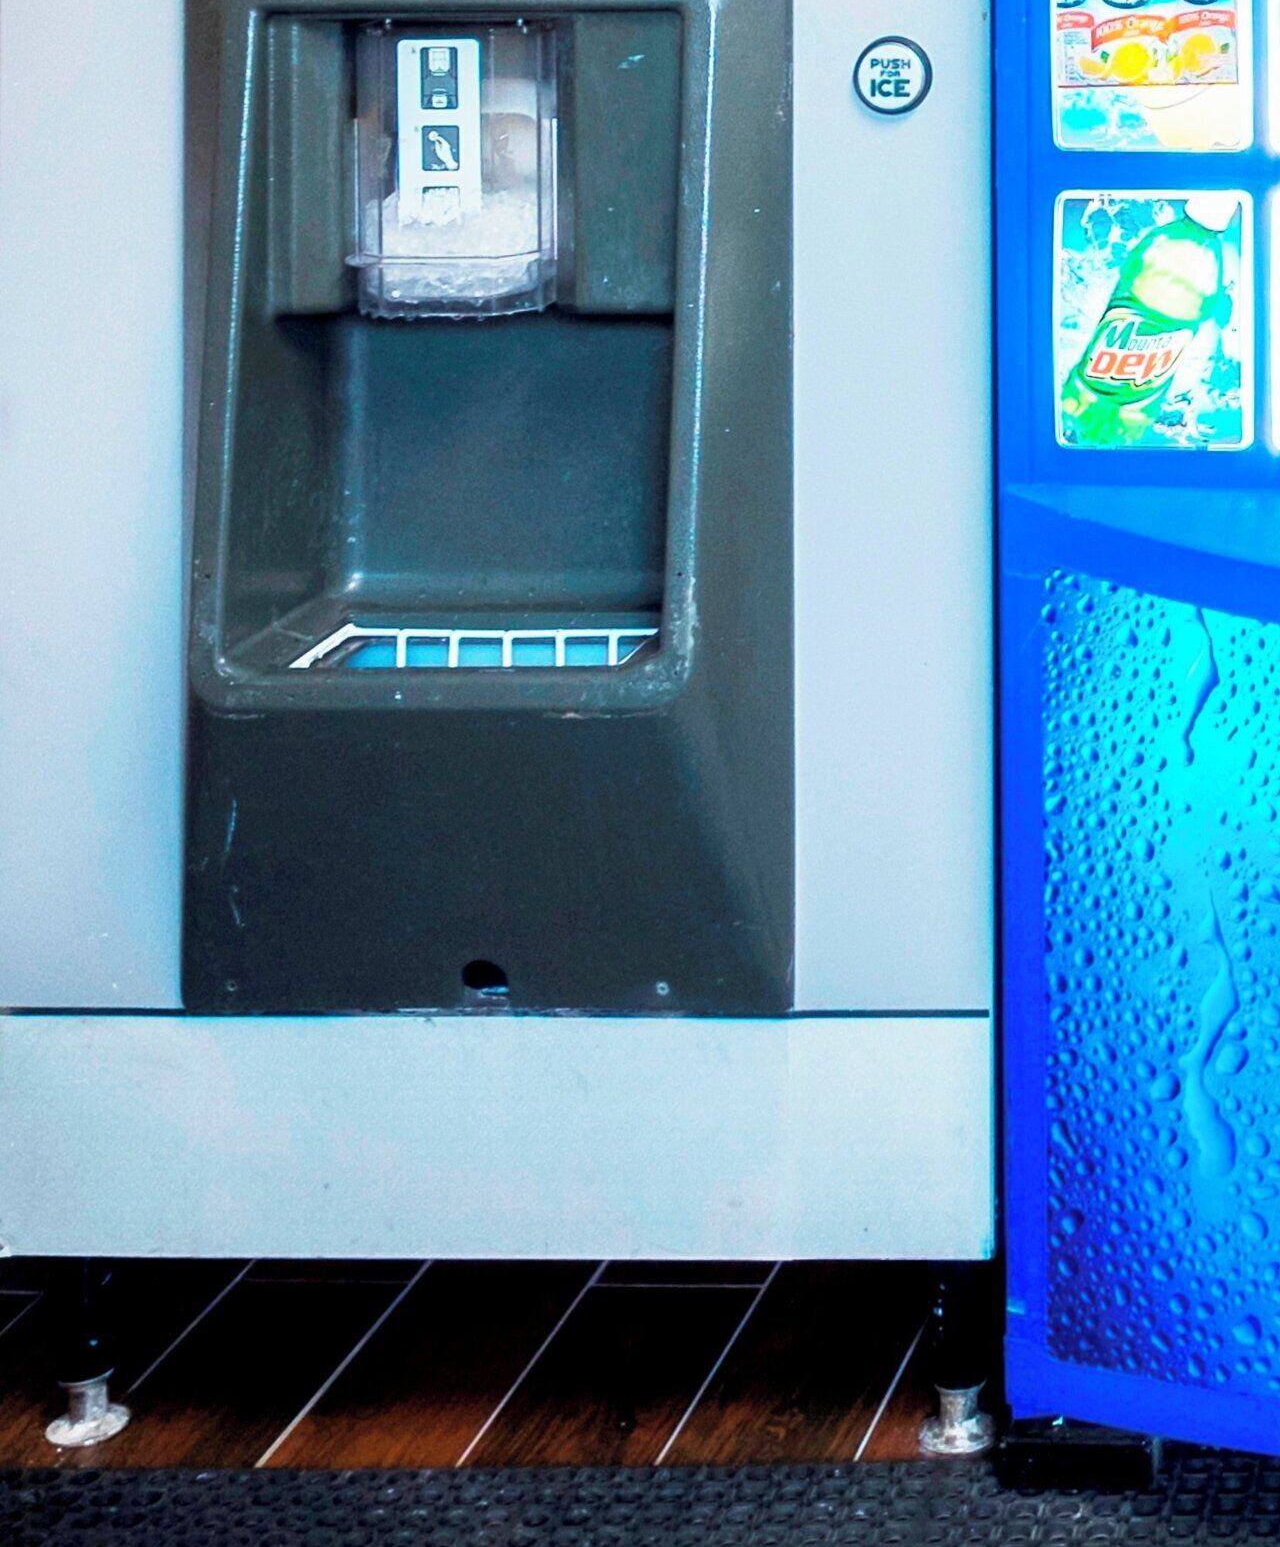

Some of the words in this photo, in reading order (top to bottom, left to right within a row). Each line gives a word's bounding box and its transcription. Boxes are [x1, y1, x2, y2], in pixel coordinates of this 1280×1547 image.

[869, 57, 912, 70] PUSH
[879, 69, 902, 78] FOR
[869, 78, 911, 98] ICE
